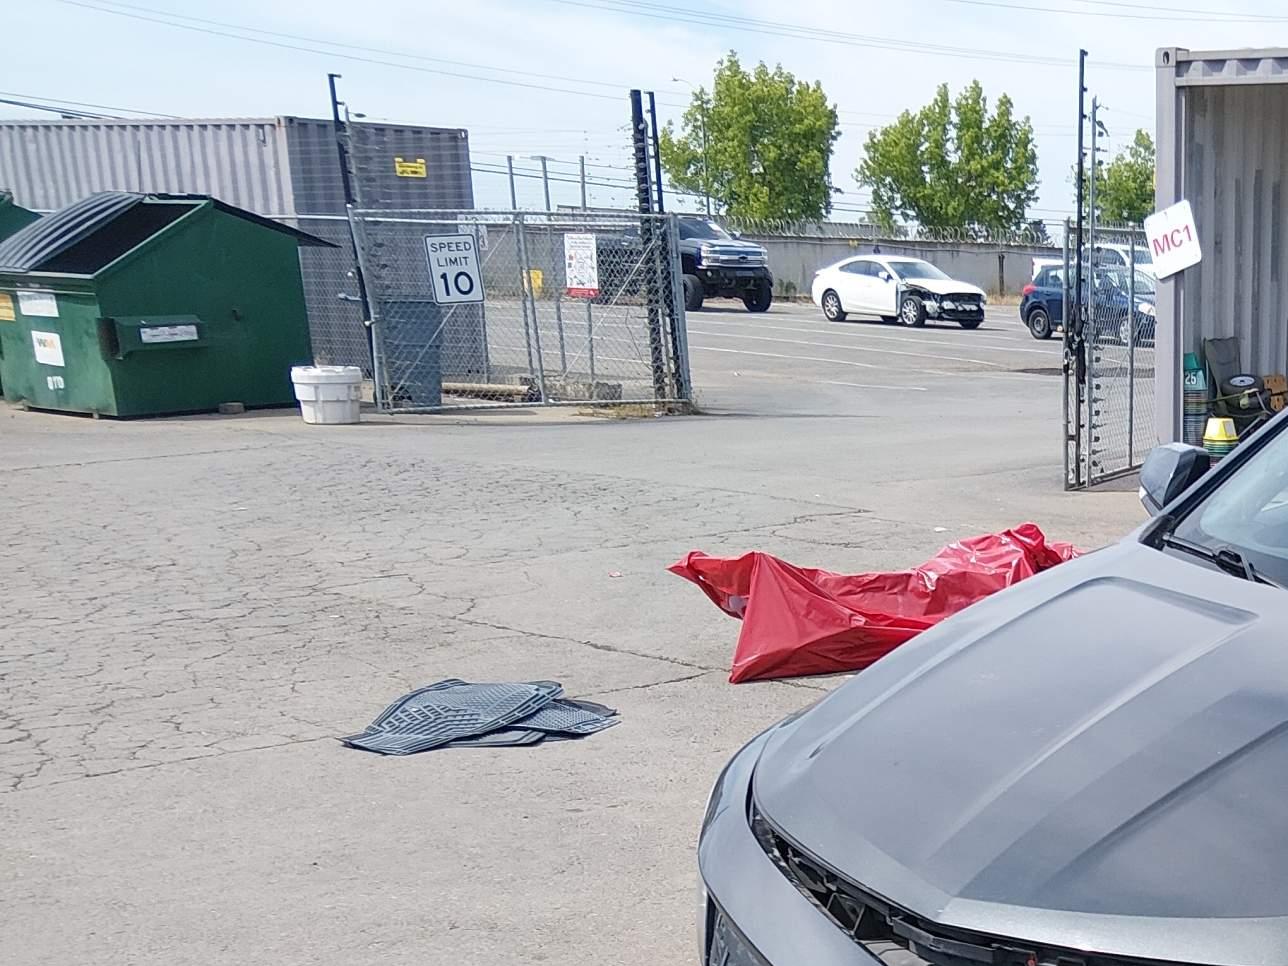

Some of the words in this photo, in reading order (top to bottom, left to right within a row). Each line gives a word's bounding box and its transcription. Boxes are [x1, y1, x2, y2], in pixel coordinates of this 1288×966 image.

[430, 241, 472, 253] SPEED
[1152, 224, 1193, 257] MC1
[436, 256, 470, 267] LIMIT
[440, 270, 474, 297] 10
